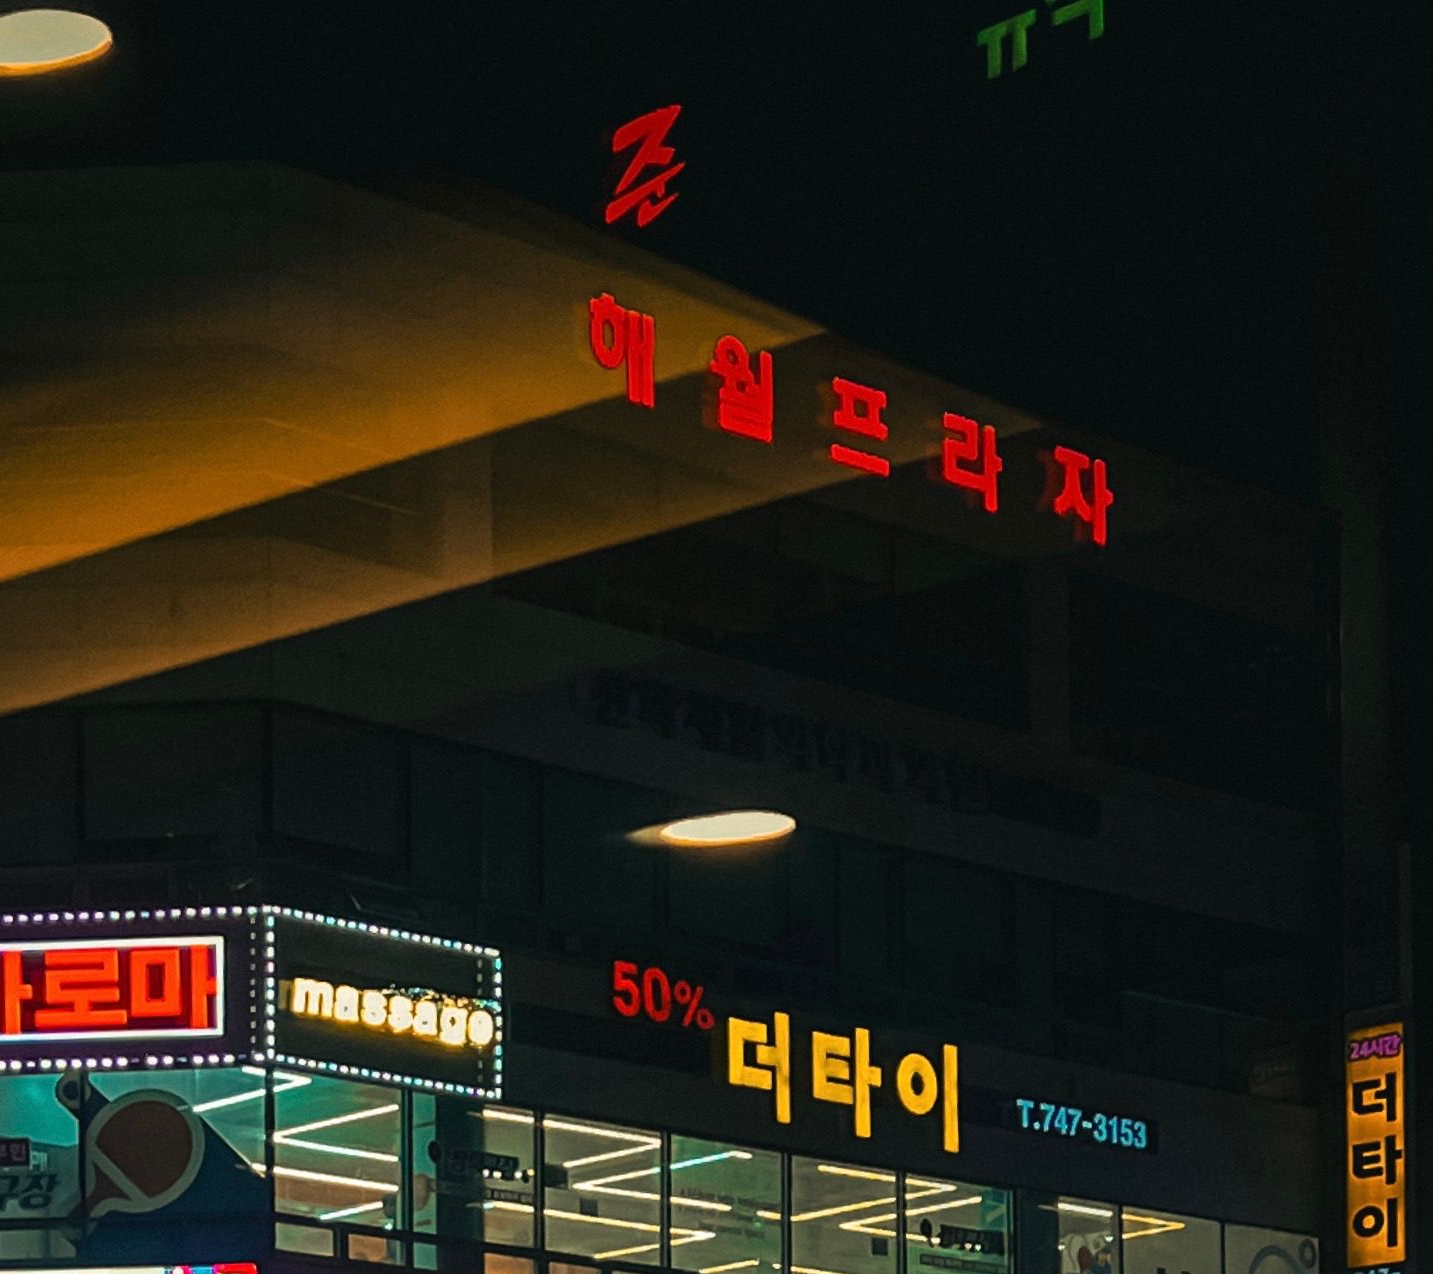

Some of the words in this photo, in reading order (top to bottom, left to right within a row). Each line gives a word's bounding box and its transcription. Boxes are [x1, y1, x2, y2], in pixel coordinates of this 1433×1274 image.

[291, 976, 494, 1046] massage
[614, 960, 715, 1030] 50%
[1350, 1035, 1401, 1059] 24시간
[727, 1012, 959, 1153] 더타이
[1016, 1099, 1147, 1149] T.747-3153
[1351, 1072, 1402, 1248] 더타이
